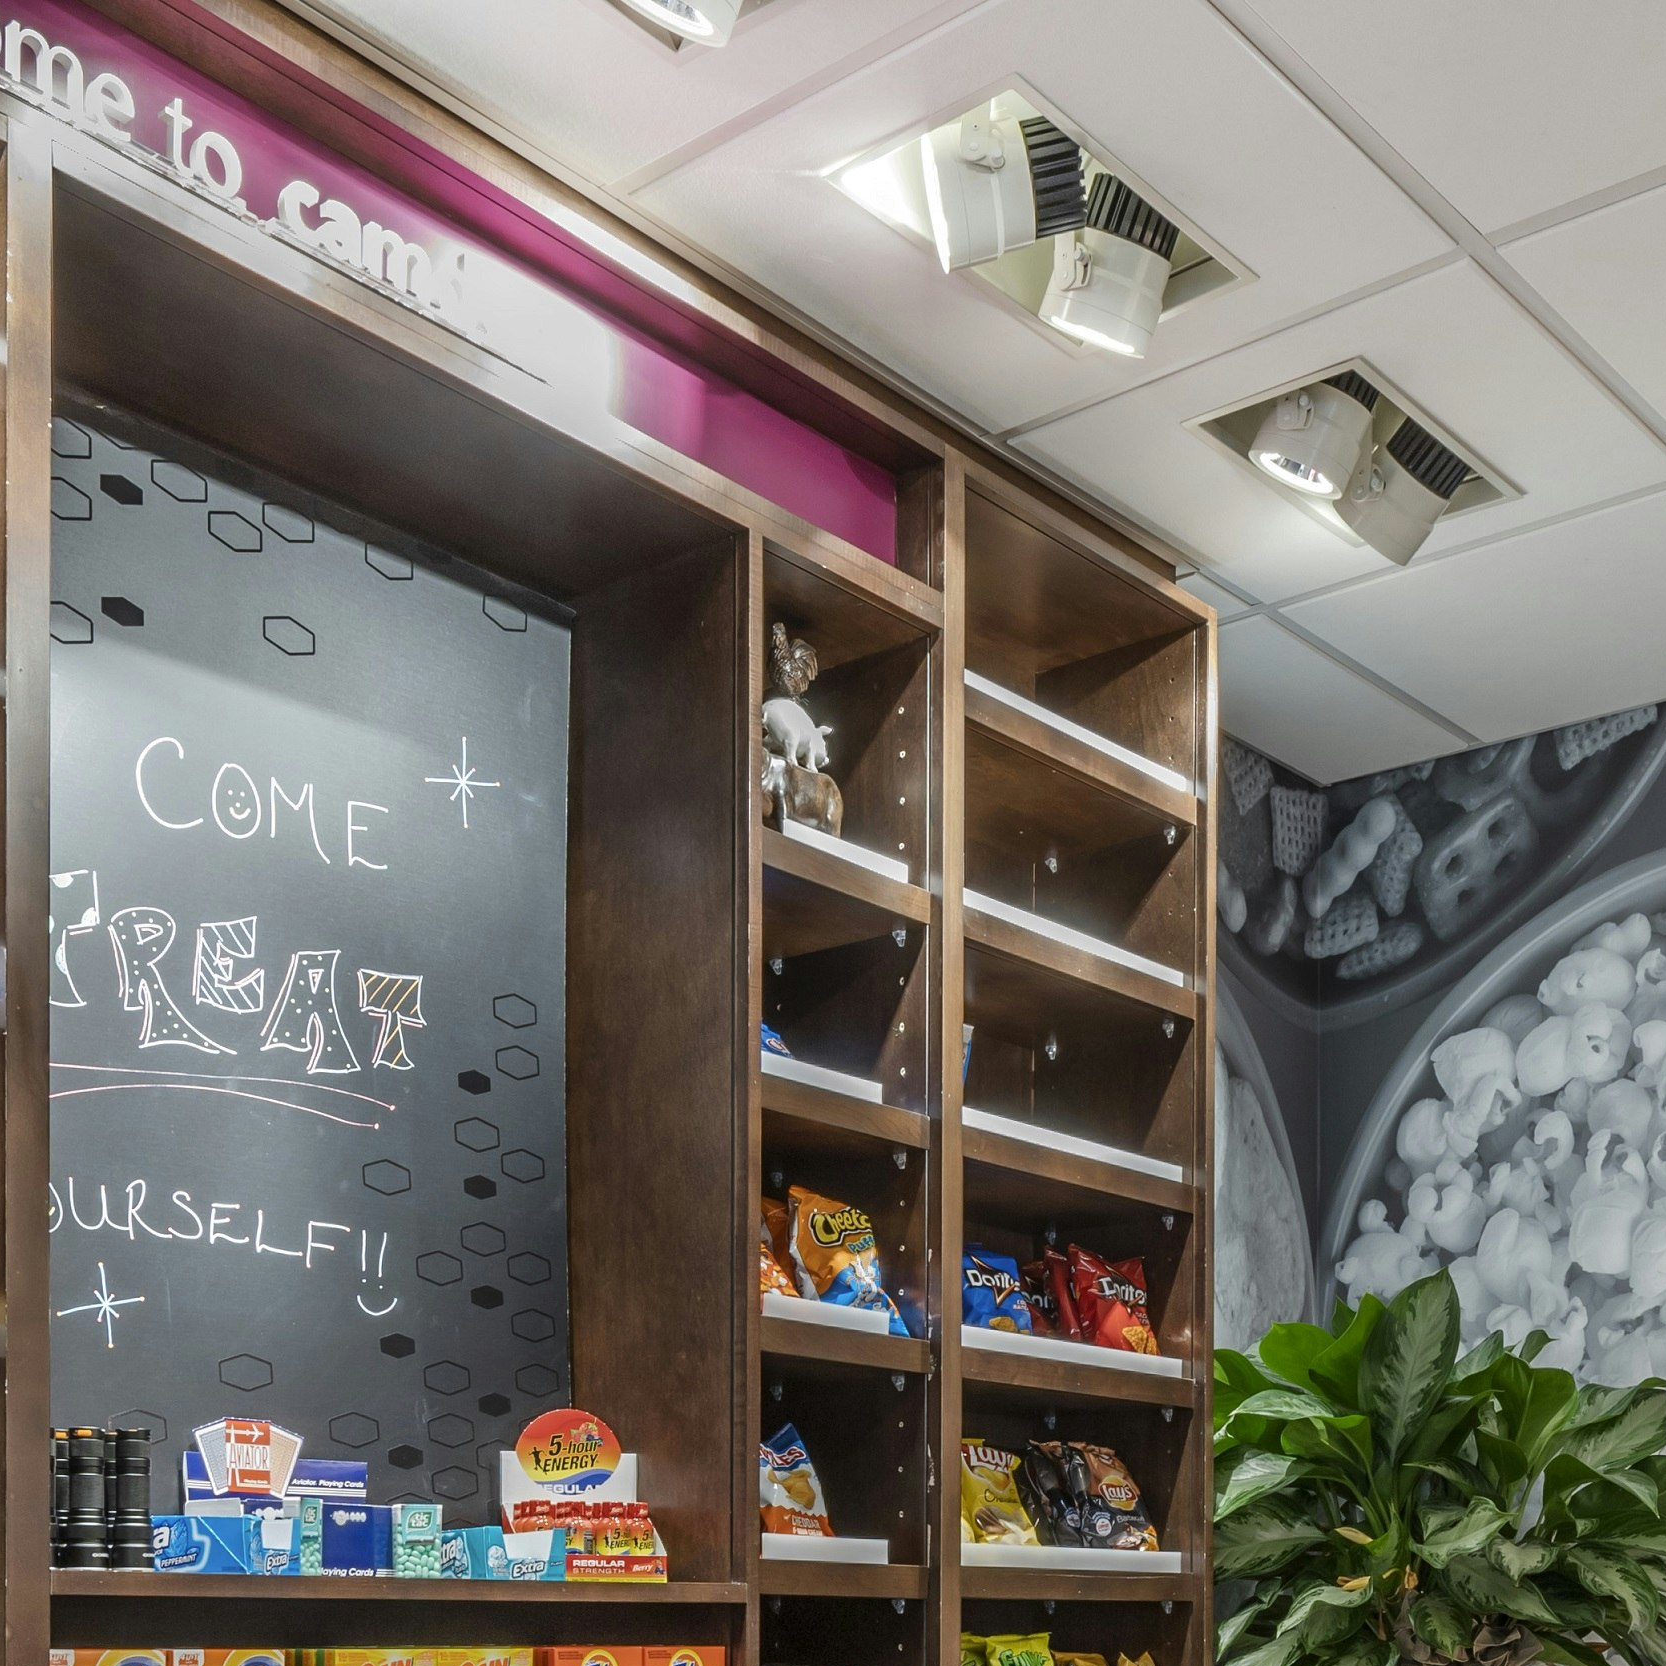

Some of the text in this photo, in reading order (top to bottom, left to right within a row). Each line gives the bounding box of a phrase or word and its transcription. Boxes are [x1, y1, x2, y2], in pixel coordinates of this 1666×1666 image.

[159, 97, 242, 198] to
[136, 736, 389, 869] COME
[548, 1435, 600, 1456] 5-hour
[229, 1445, 270, 1470] AVIATOR
[543, 1454, 599, 1473] ENERGY
[345, 1480, 364, 1488] Cards
[1100, 1481, 1135, 1502] Lay's
[410, 1519, 430, 1529] tac
[413, 1511, 430, 1522] tic
[161, 1553, 197, 1568] PEPPERMINT
[572, 1559, 625, 1567] REGULAR
[632, 1563, 653, 1573] Berry
[346, 1568, 374, 1577] Cards
